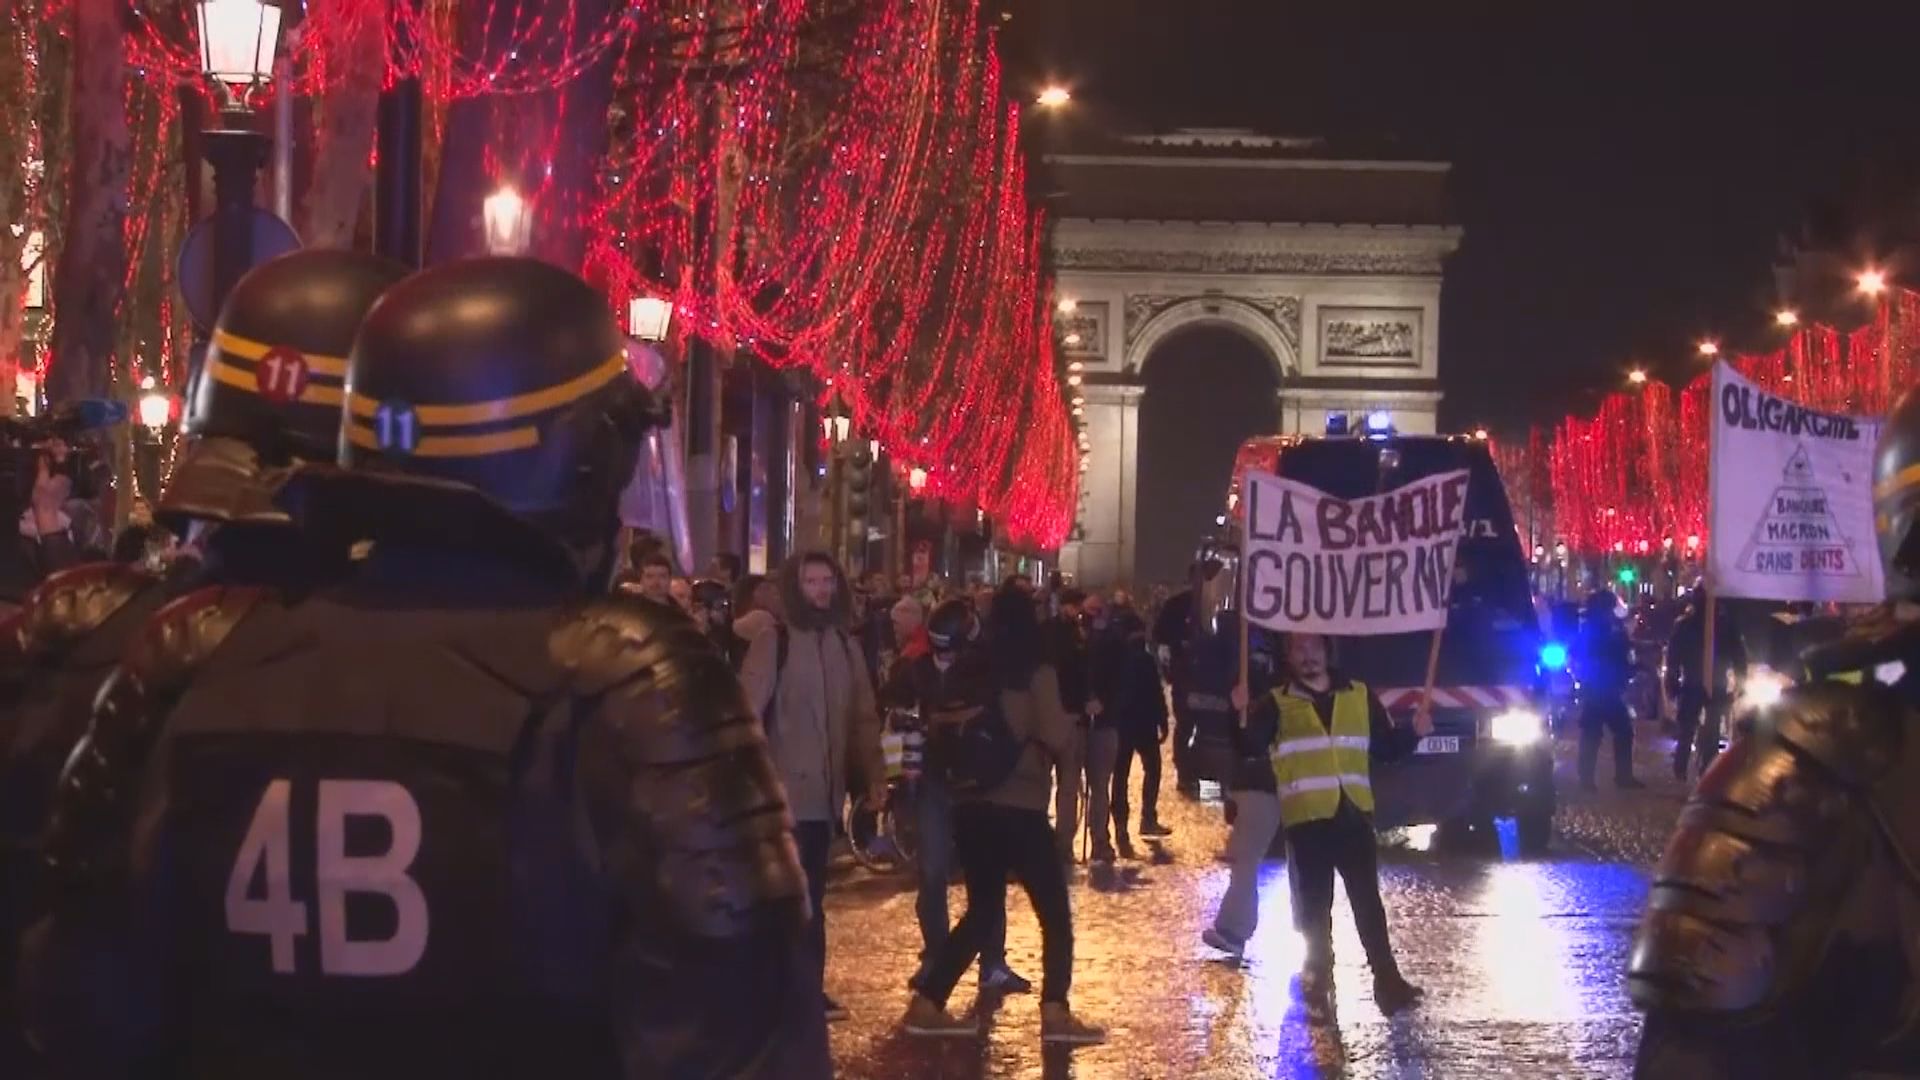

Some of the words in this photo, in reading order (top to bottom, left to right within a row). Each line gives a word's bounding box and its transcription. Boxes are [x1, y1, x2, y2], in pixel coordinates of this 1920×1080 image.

[266, 356, 301, 396] 11
[378, 405, 414, 453] 11
[1250, 480, 1303, 545] LA
[1767, 522, 1830, 540] MACRON
[1246, 541, 1452, 621] GOUVERNE
[1756, 551, 1793, 571] SANS
[1800, 548, 1844, 570] DENTS
[225, 779, 429, 976] 4B
